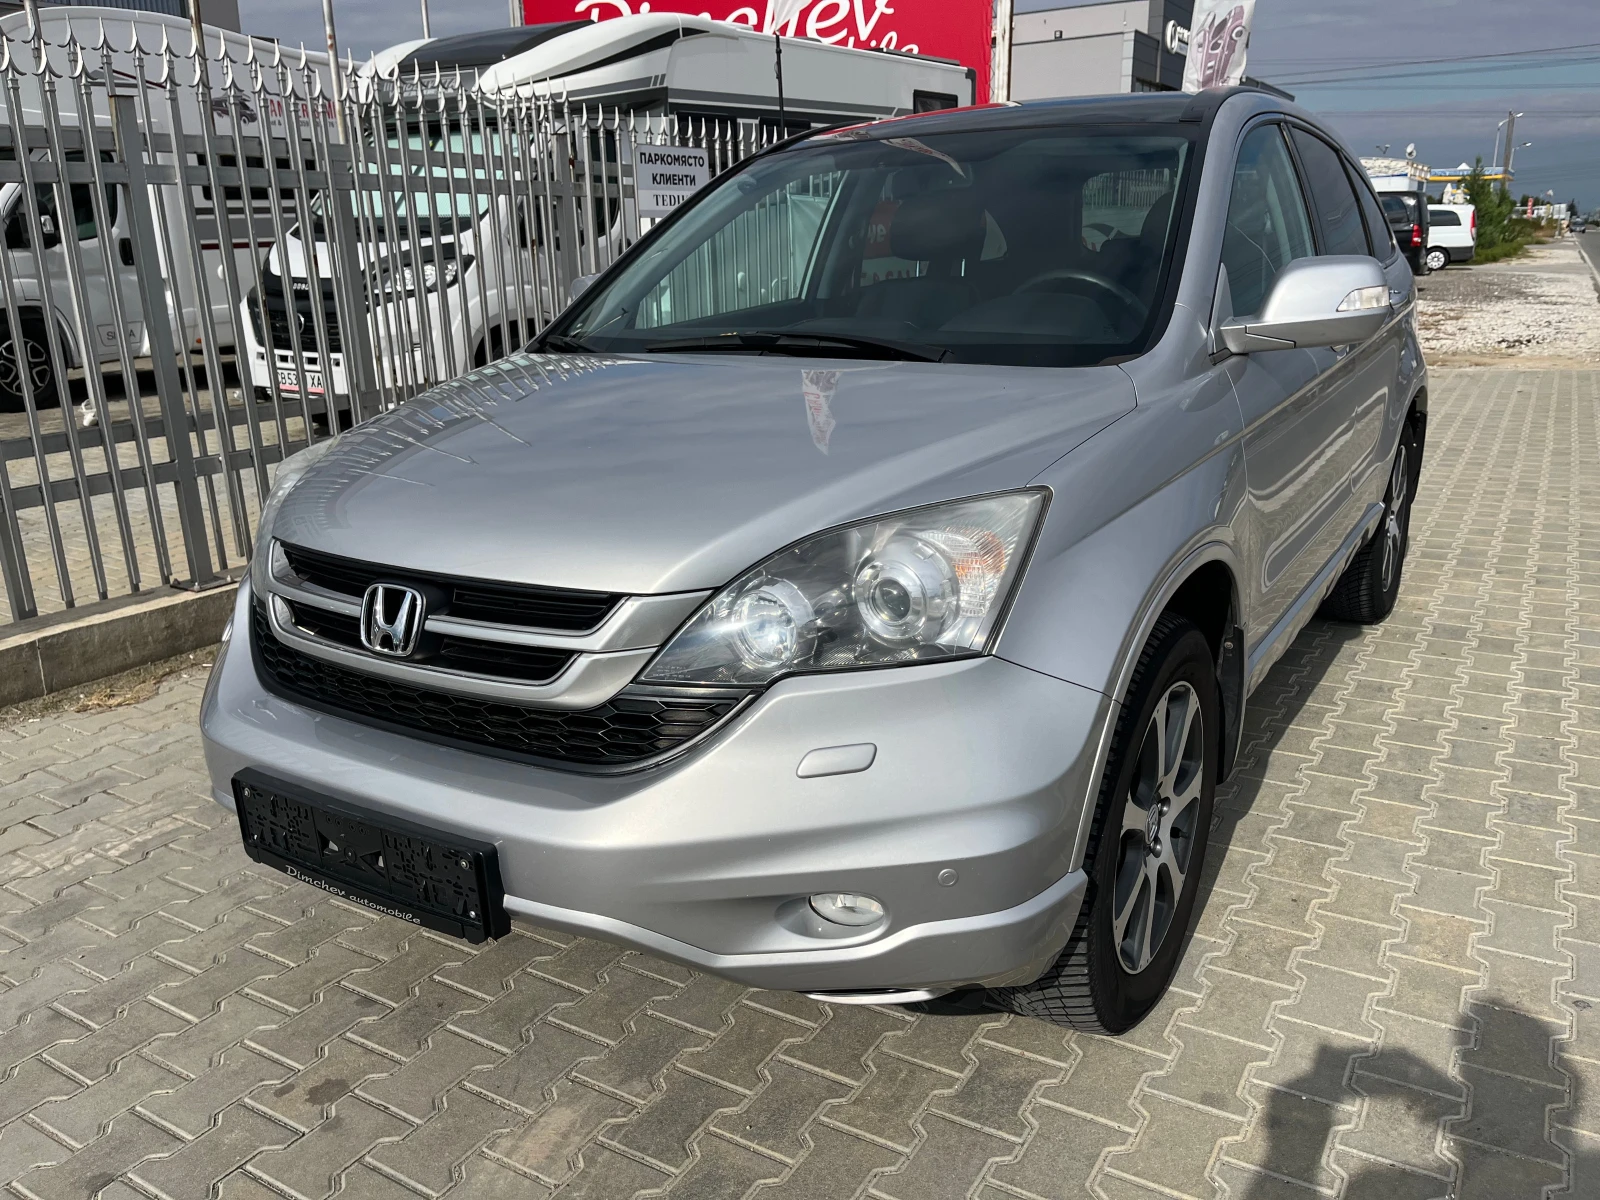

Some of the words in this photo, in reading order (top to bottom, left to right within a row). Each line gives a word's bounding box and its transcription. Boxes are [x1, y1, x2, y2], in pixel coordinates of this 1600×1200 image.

[640, 152, 705, 168] ПАРКОМЯСТО
[652, 173, 696, 187] КЛИЕНТИ
[285, 864, 346, 896] Dimchev
[349, 894, 421, 925] automobile
